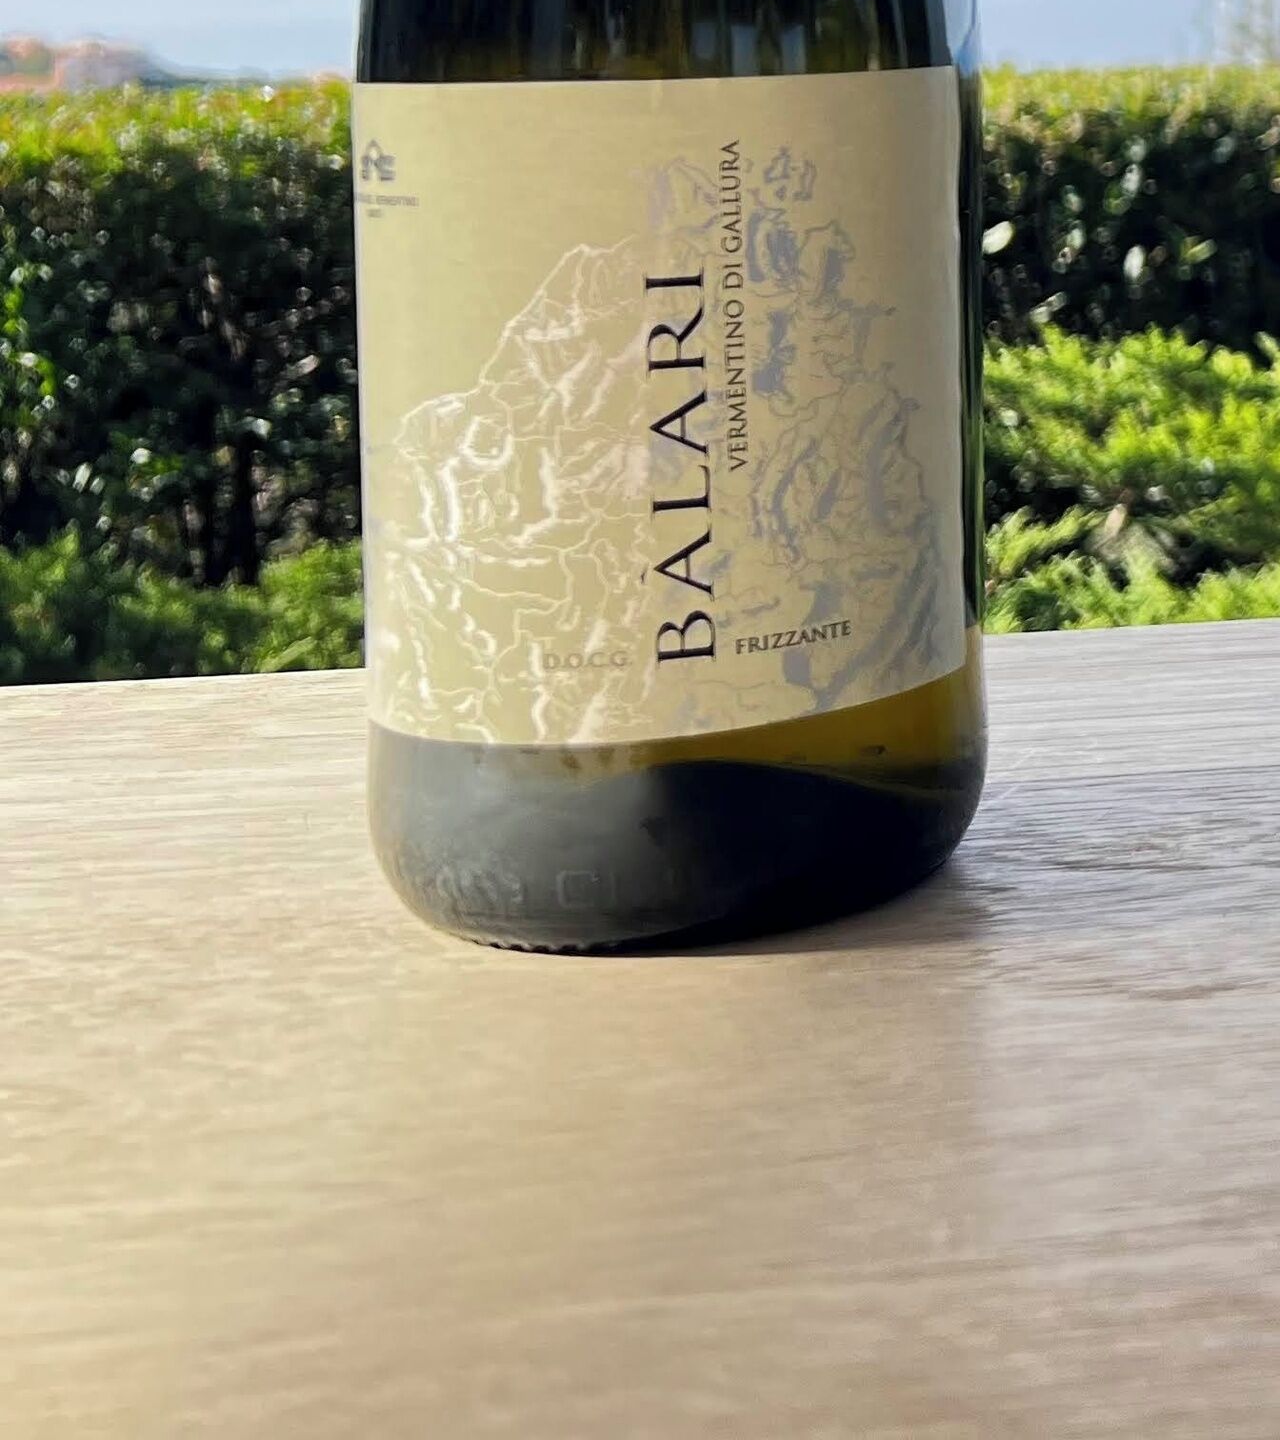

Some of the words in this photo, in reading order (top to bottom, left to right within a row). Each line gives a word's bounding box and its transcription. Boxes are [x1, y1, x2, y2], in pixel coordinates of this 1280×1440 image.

[719, 139, 742, 251] GALLURA
[726, 261, 745, 292] DI
[727, 298, 749, 472] VERMENTINO
[644, 266, 717, 667] BALARI
[735, 619, 852, 655] FRIZZANTE
